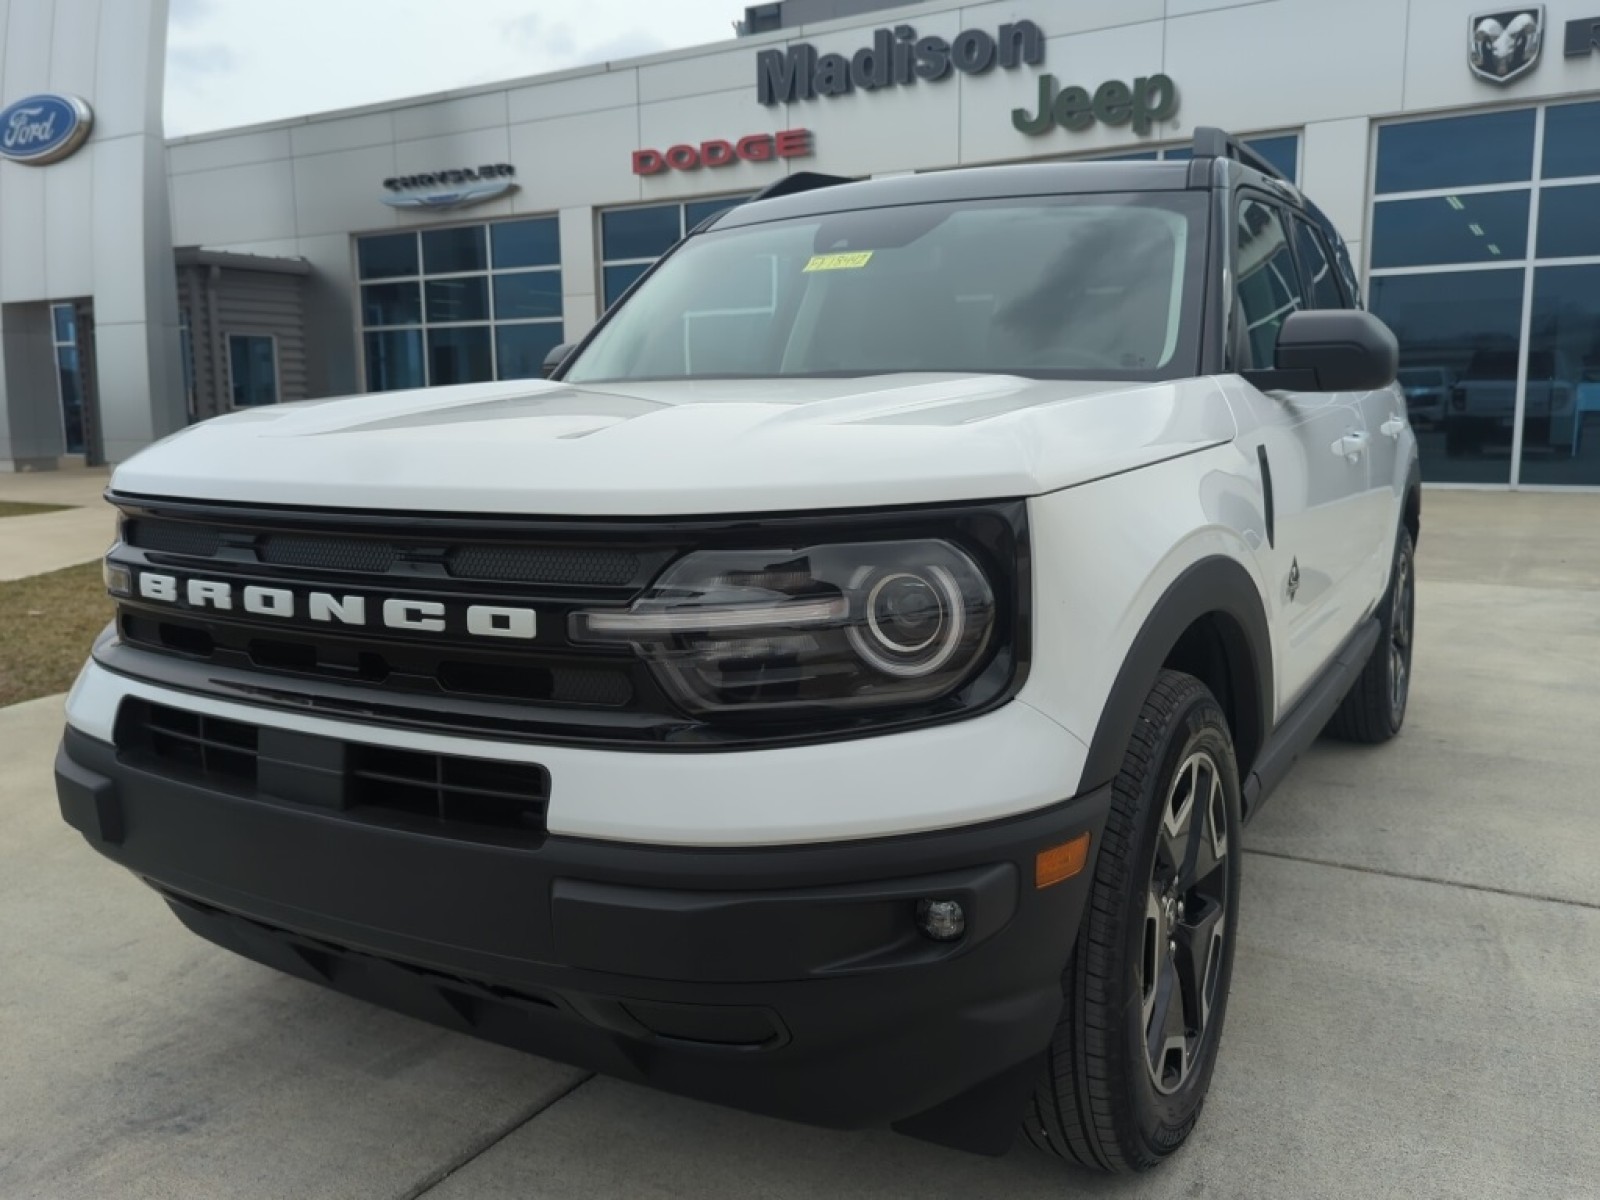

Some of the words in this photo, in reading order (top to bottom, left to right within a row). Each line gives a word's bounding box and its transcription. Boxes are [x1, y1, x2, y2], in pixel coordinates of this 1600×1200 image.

[757, 19, 1045, 106] Madison
[4, 106, 56, 147] Ford
[1012, 73, 1178, 136] Jeep
[383, 164, 515, 192] CHRYSLER
[632, 128, 812, 175] DODGE
[139, 572, 537, 639] BRONCO
